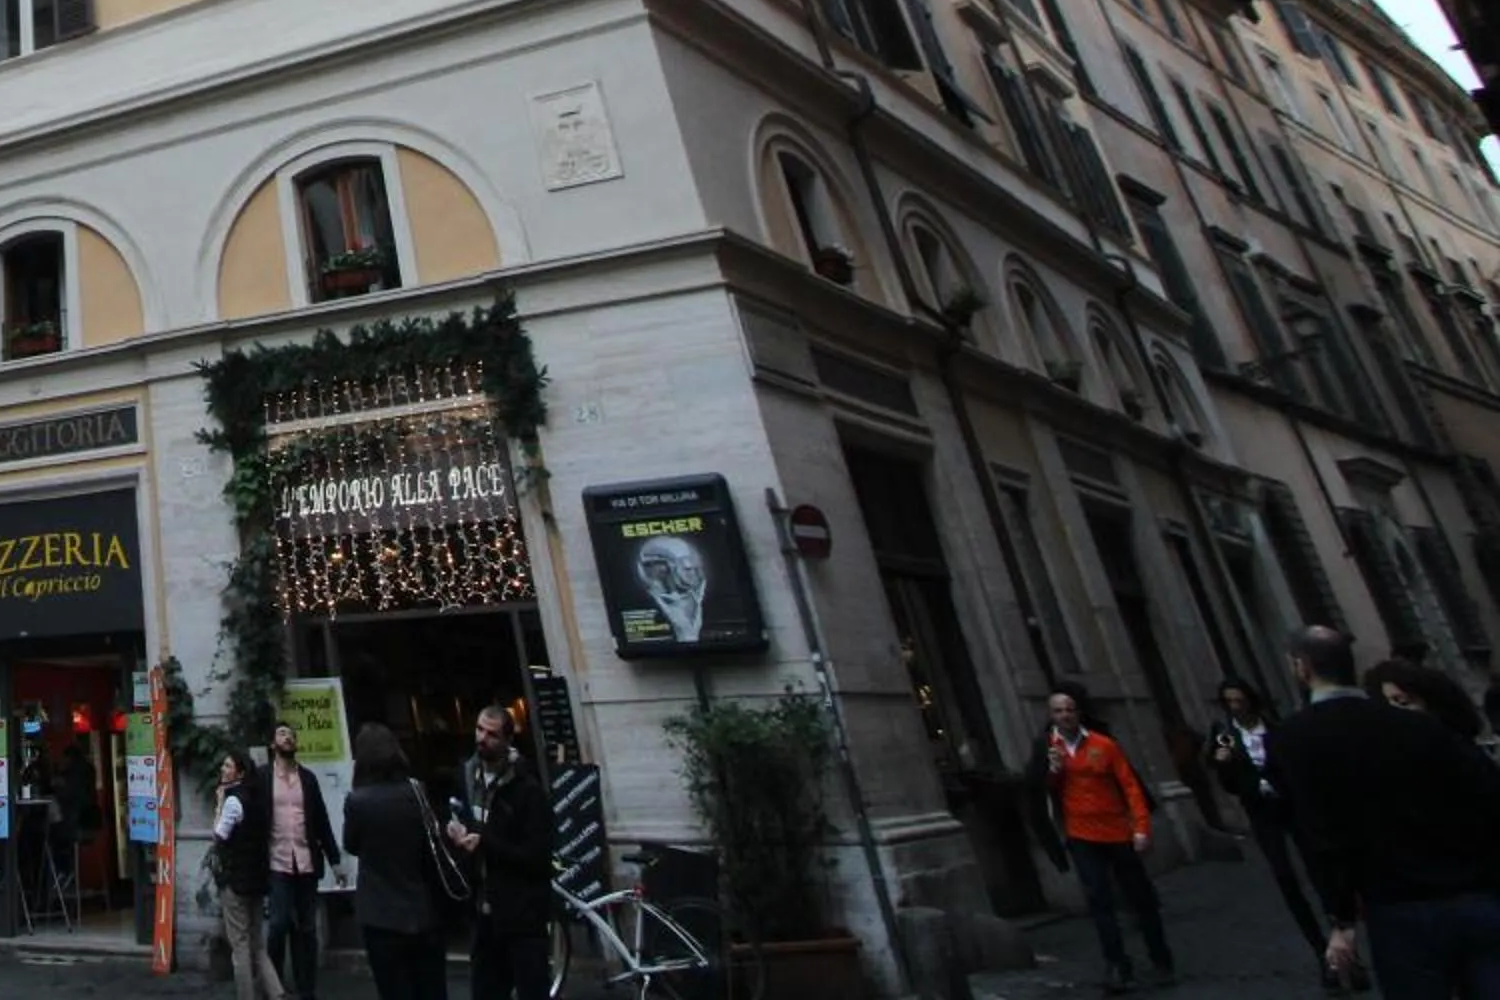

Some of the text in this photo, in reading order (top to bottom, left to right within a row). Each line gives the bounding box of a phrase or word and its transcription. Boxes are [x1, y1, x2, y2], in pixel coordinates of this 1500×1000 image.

[390, 471, 443, 507] ALLA
[449, 463, 505, 500] PACE
[621, 516, 703, 538] ESCHER
[12, 573, 101, 602] Capriccio
